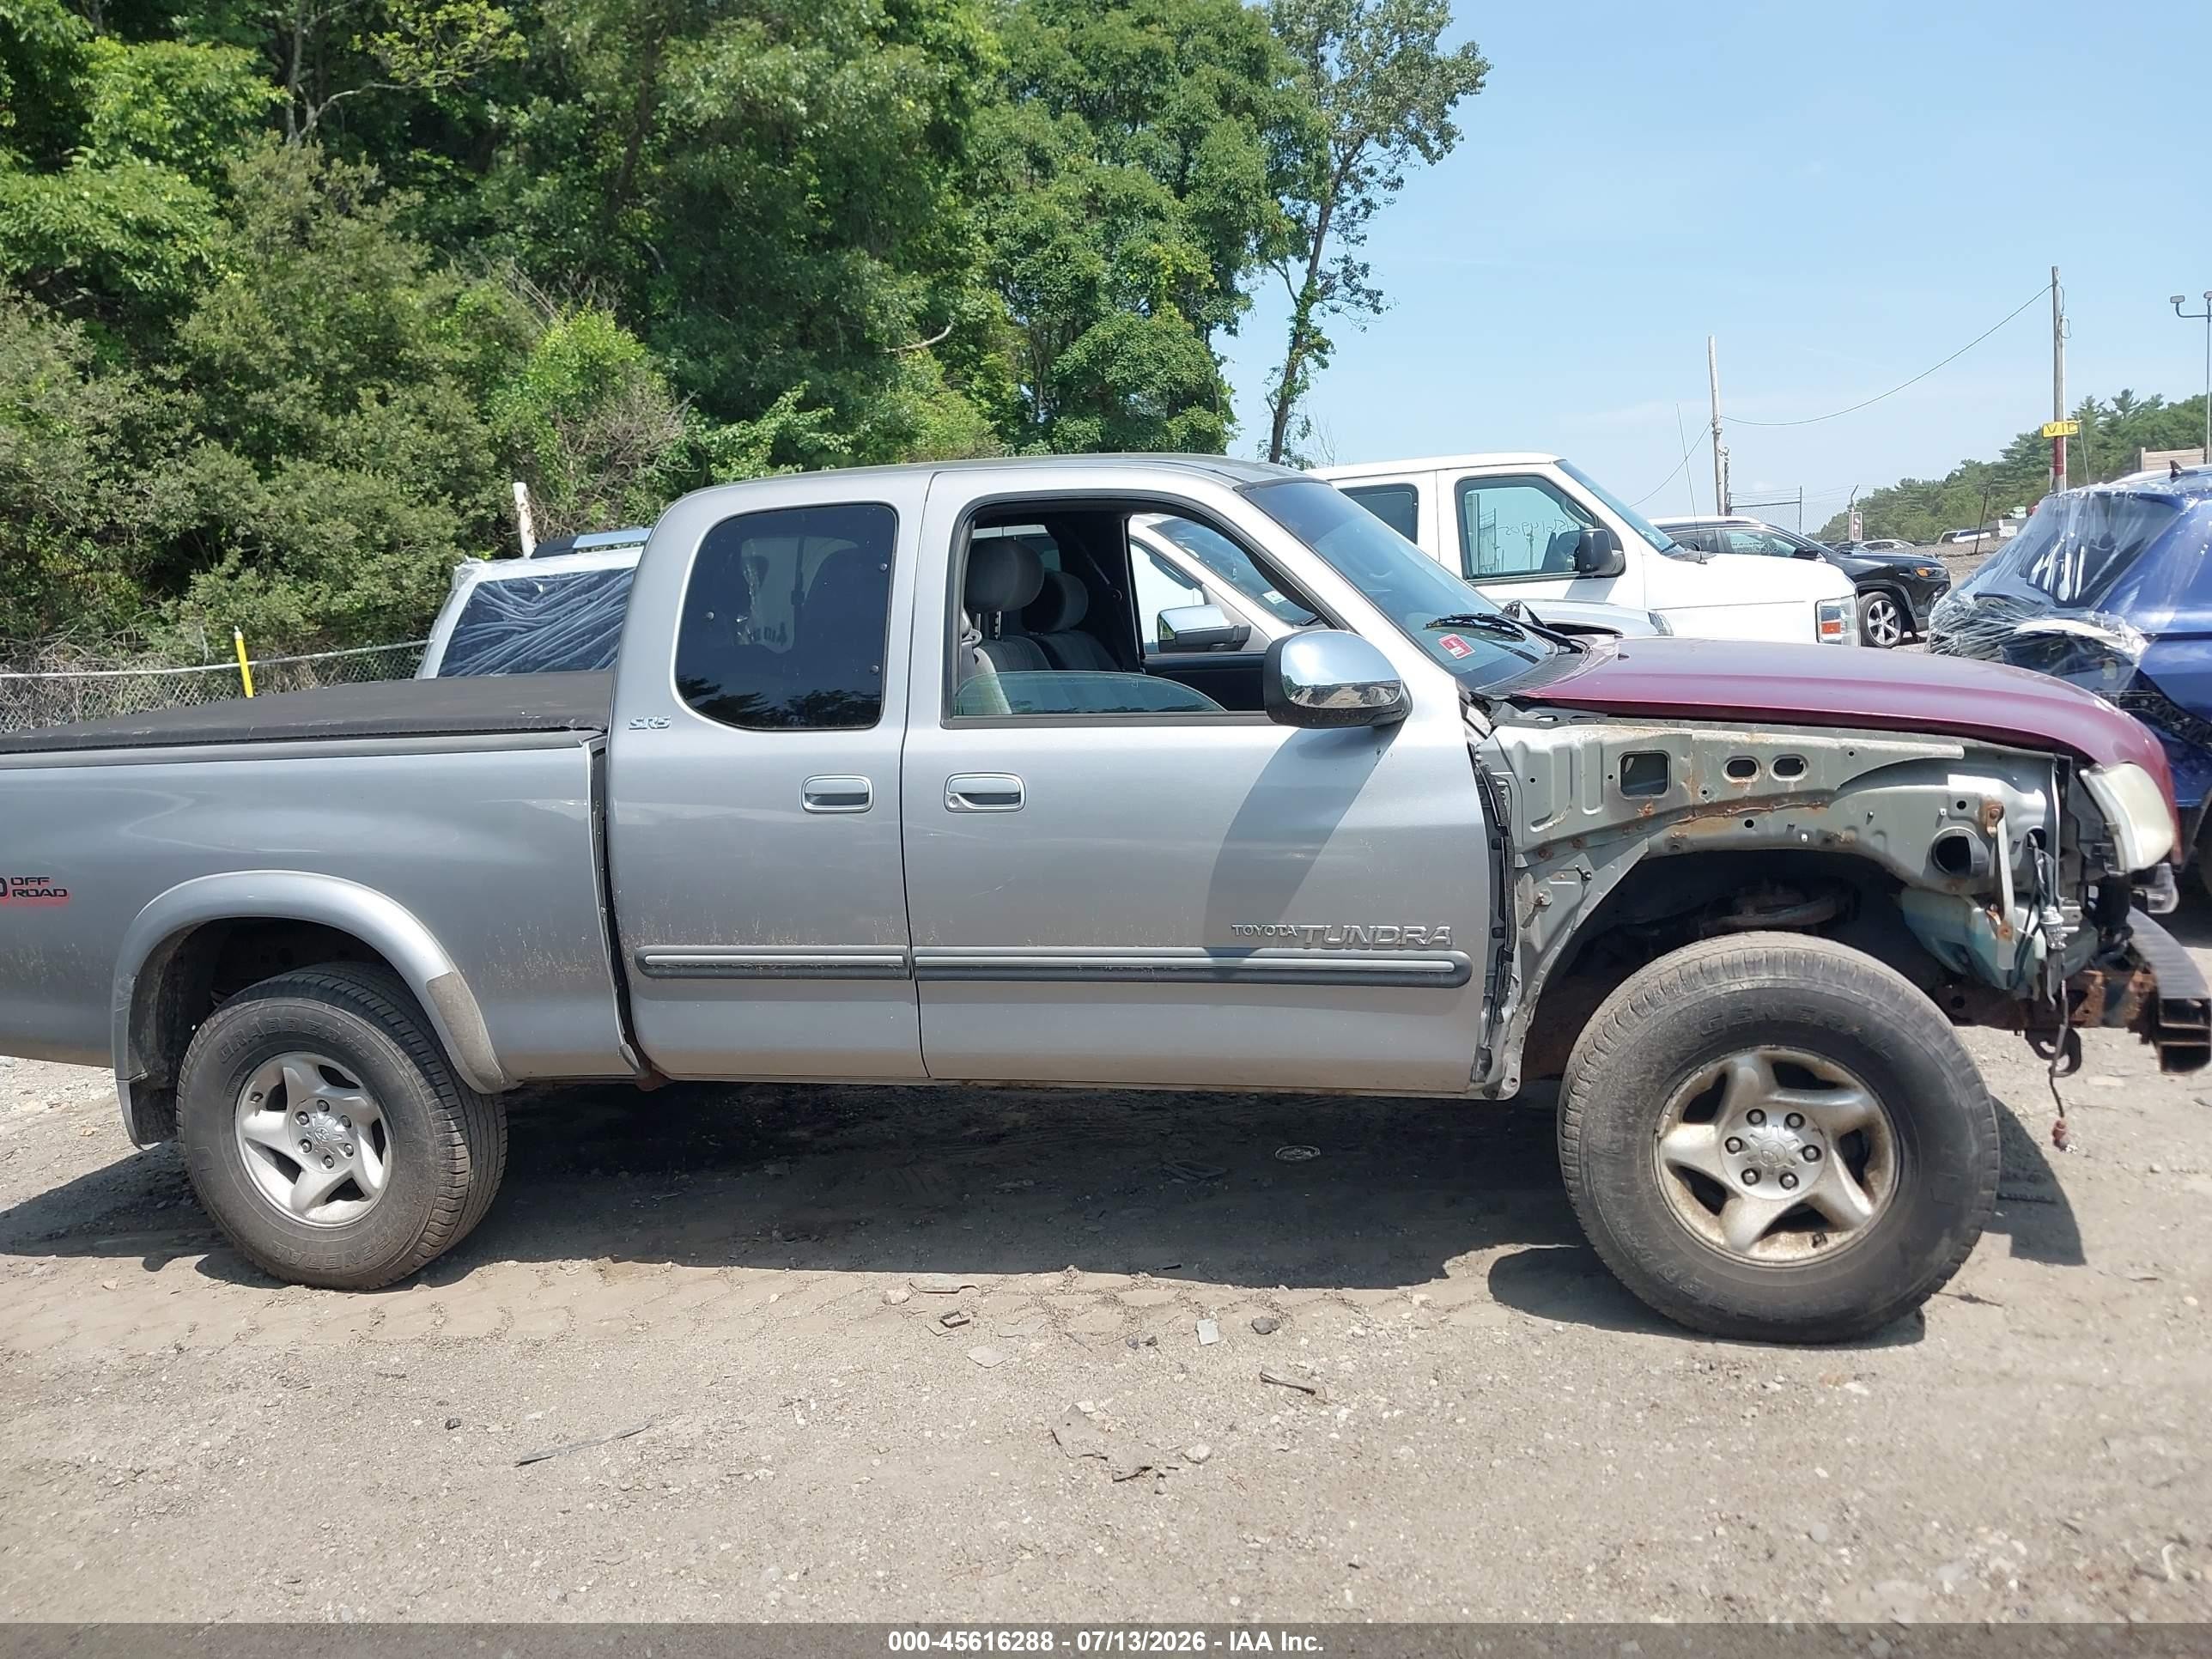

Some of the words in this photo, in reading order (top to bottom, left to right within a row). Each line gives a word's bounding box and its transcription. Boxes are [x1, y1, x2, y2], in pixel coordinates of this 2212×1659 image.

[10, 877, 50, 886] OFF
[12, 888, 68, 897] ROAD
[1231, 923, 1298, 937] TOYOTA
[1296, 924, 1455, 946] TUNDRA
[219, 1017, 342, 1064] GRABBER
[1698, 1002, 1892, 1061] GENERAL
